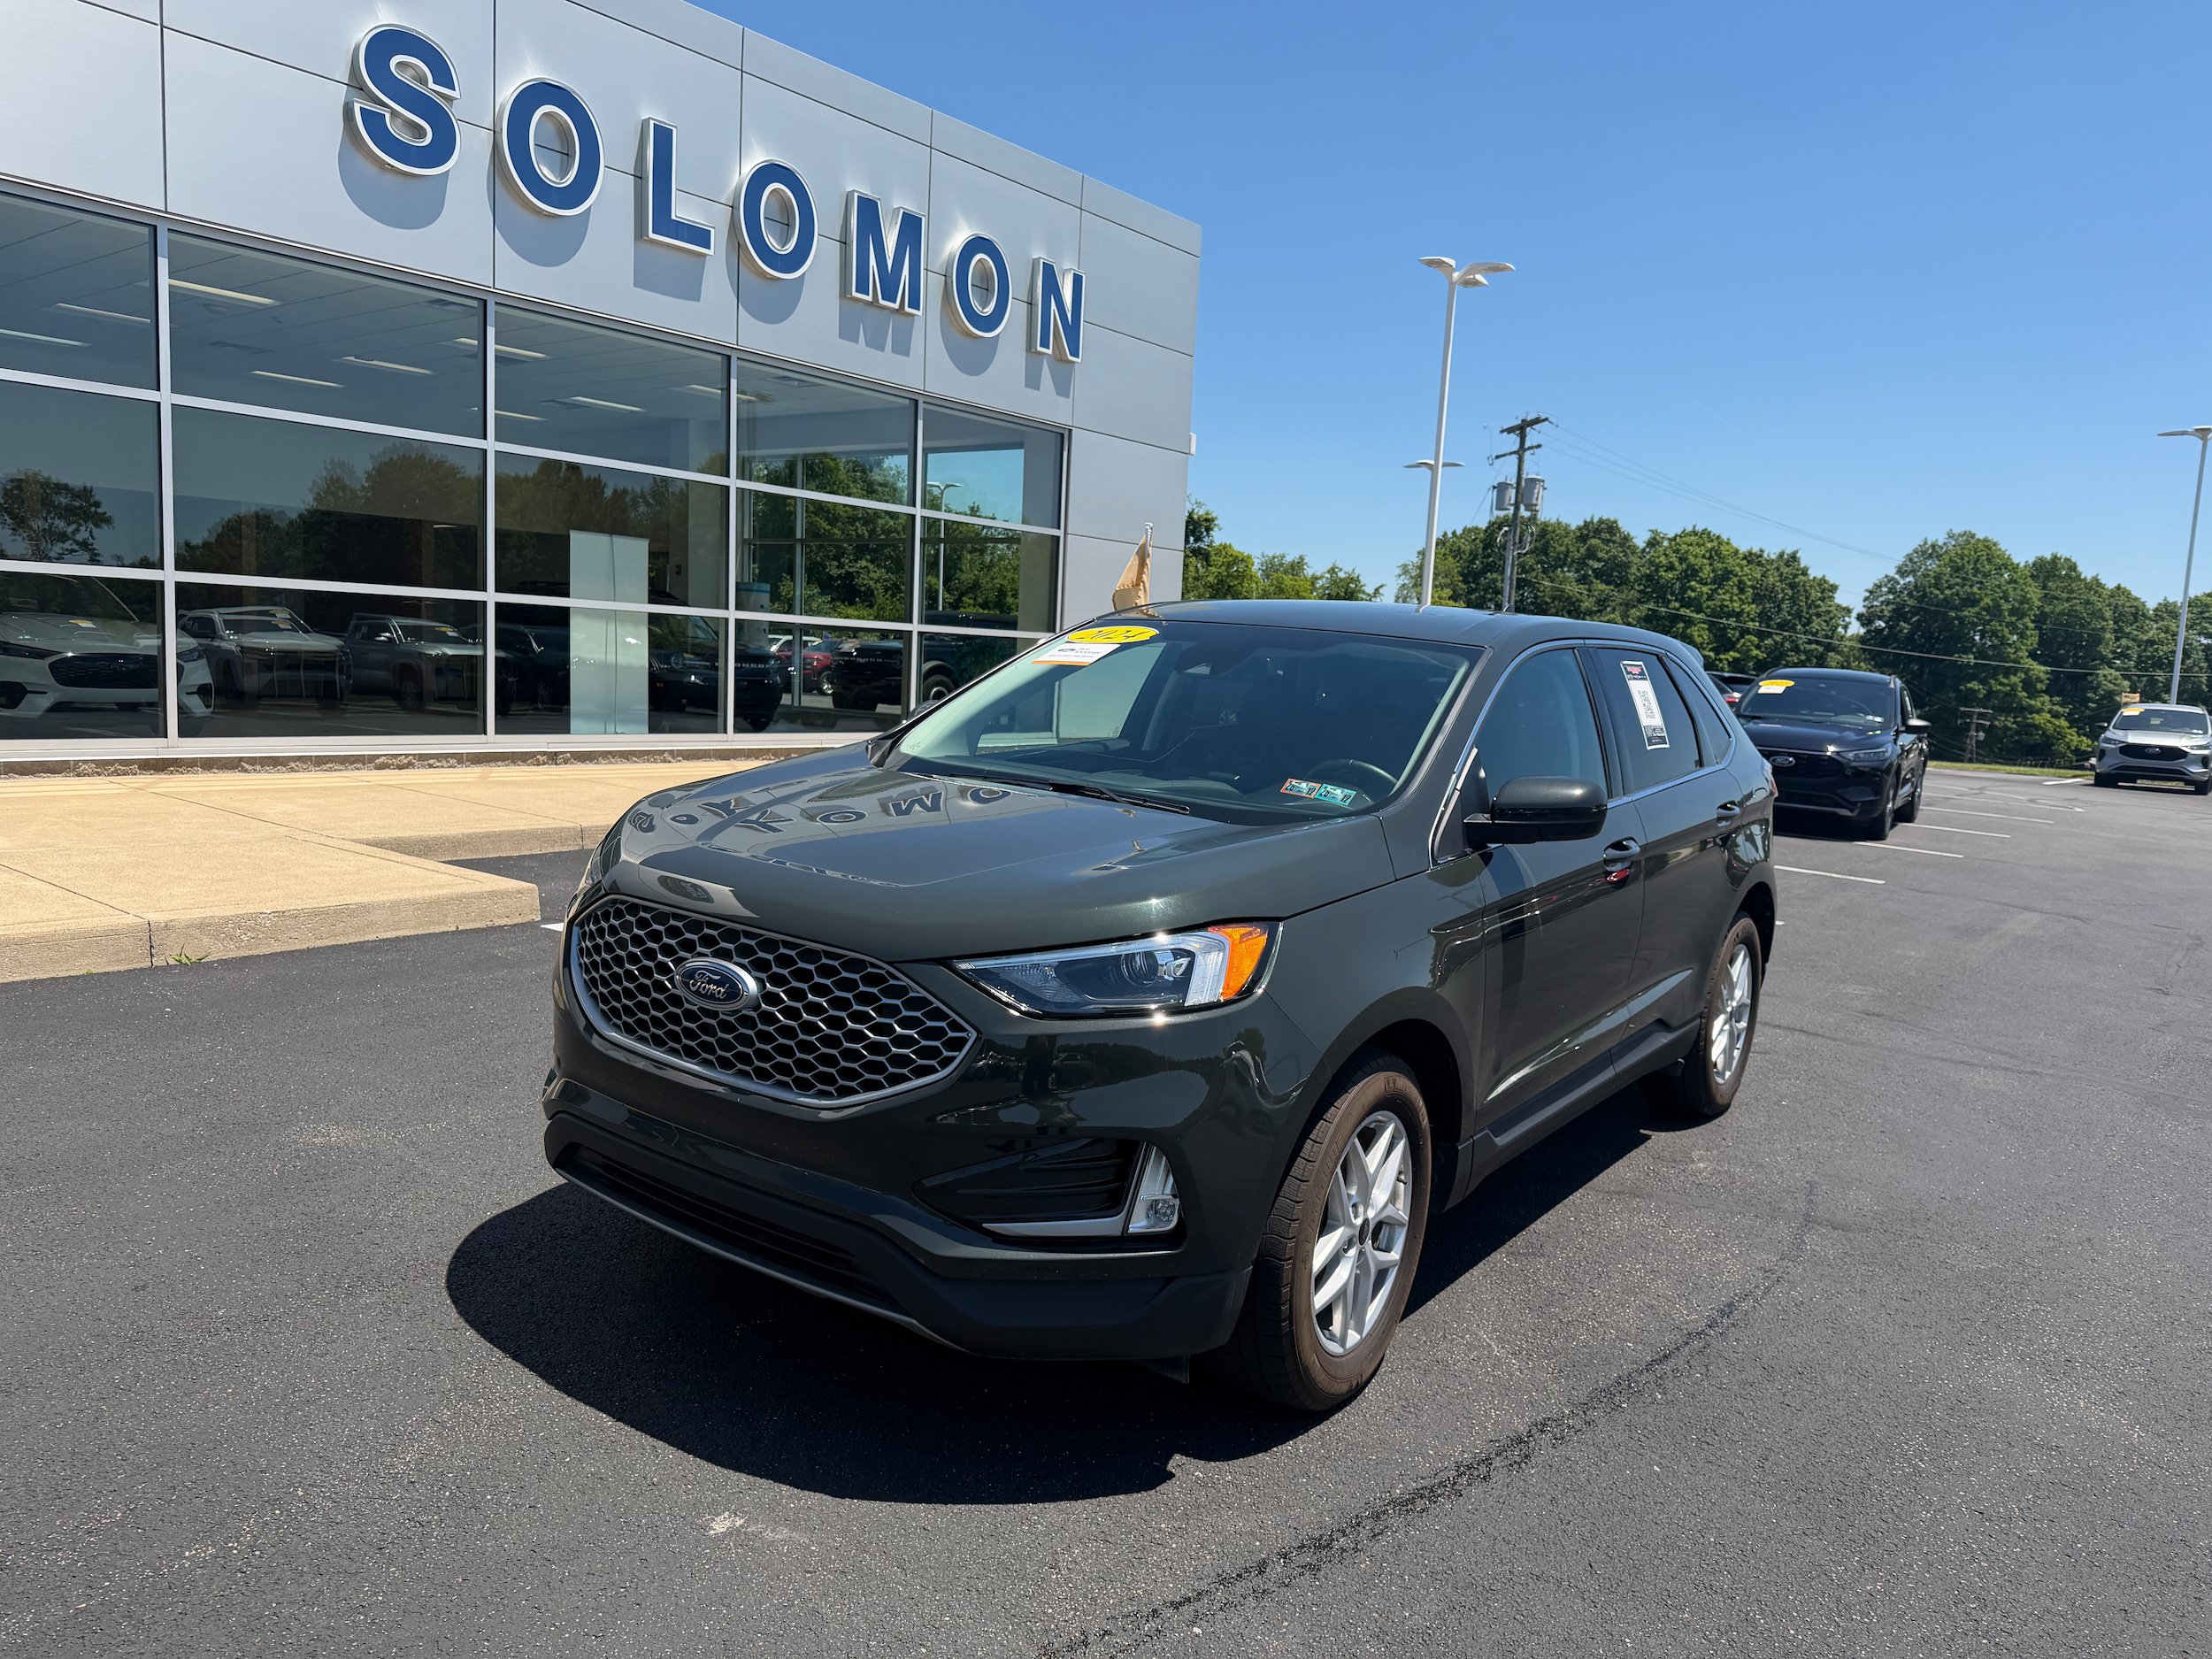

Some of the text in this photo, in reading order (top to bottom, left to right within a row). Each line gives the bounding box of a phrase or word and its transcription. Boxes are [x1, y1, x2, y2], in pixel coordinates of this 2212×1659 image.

[348, 23, 1087, 364] SOLOMON
[1075, 629, 1150, 640] 2024
[1306, 787, 1317, 796] 12
[1340, 793, 1352, 803] 12
[688, 970, 730, 1000] Ford
